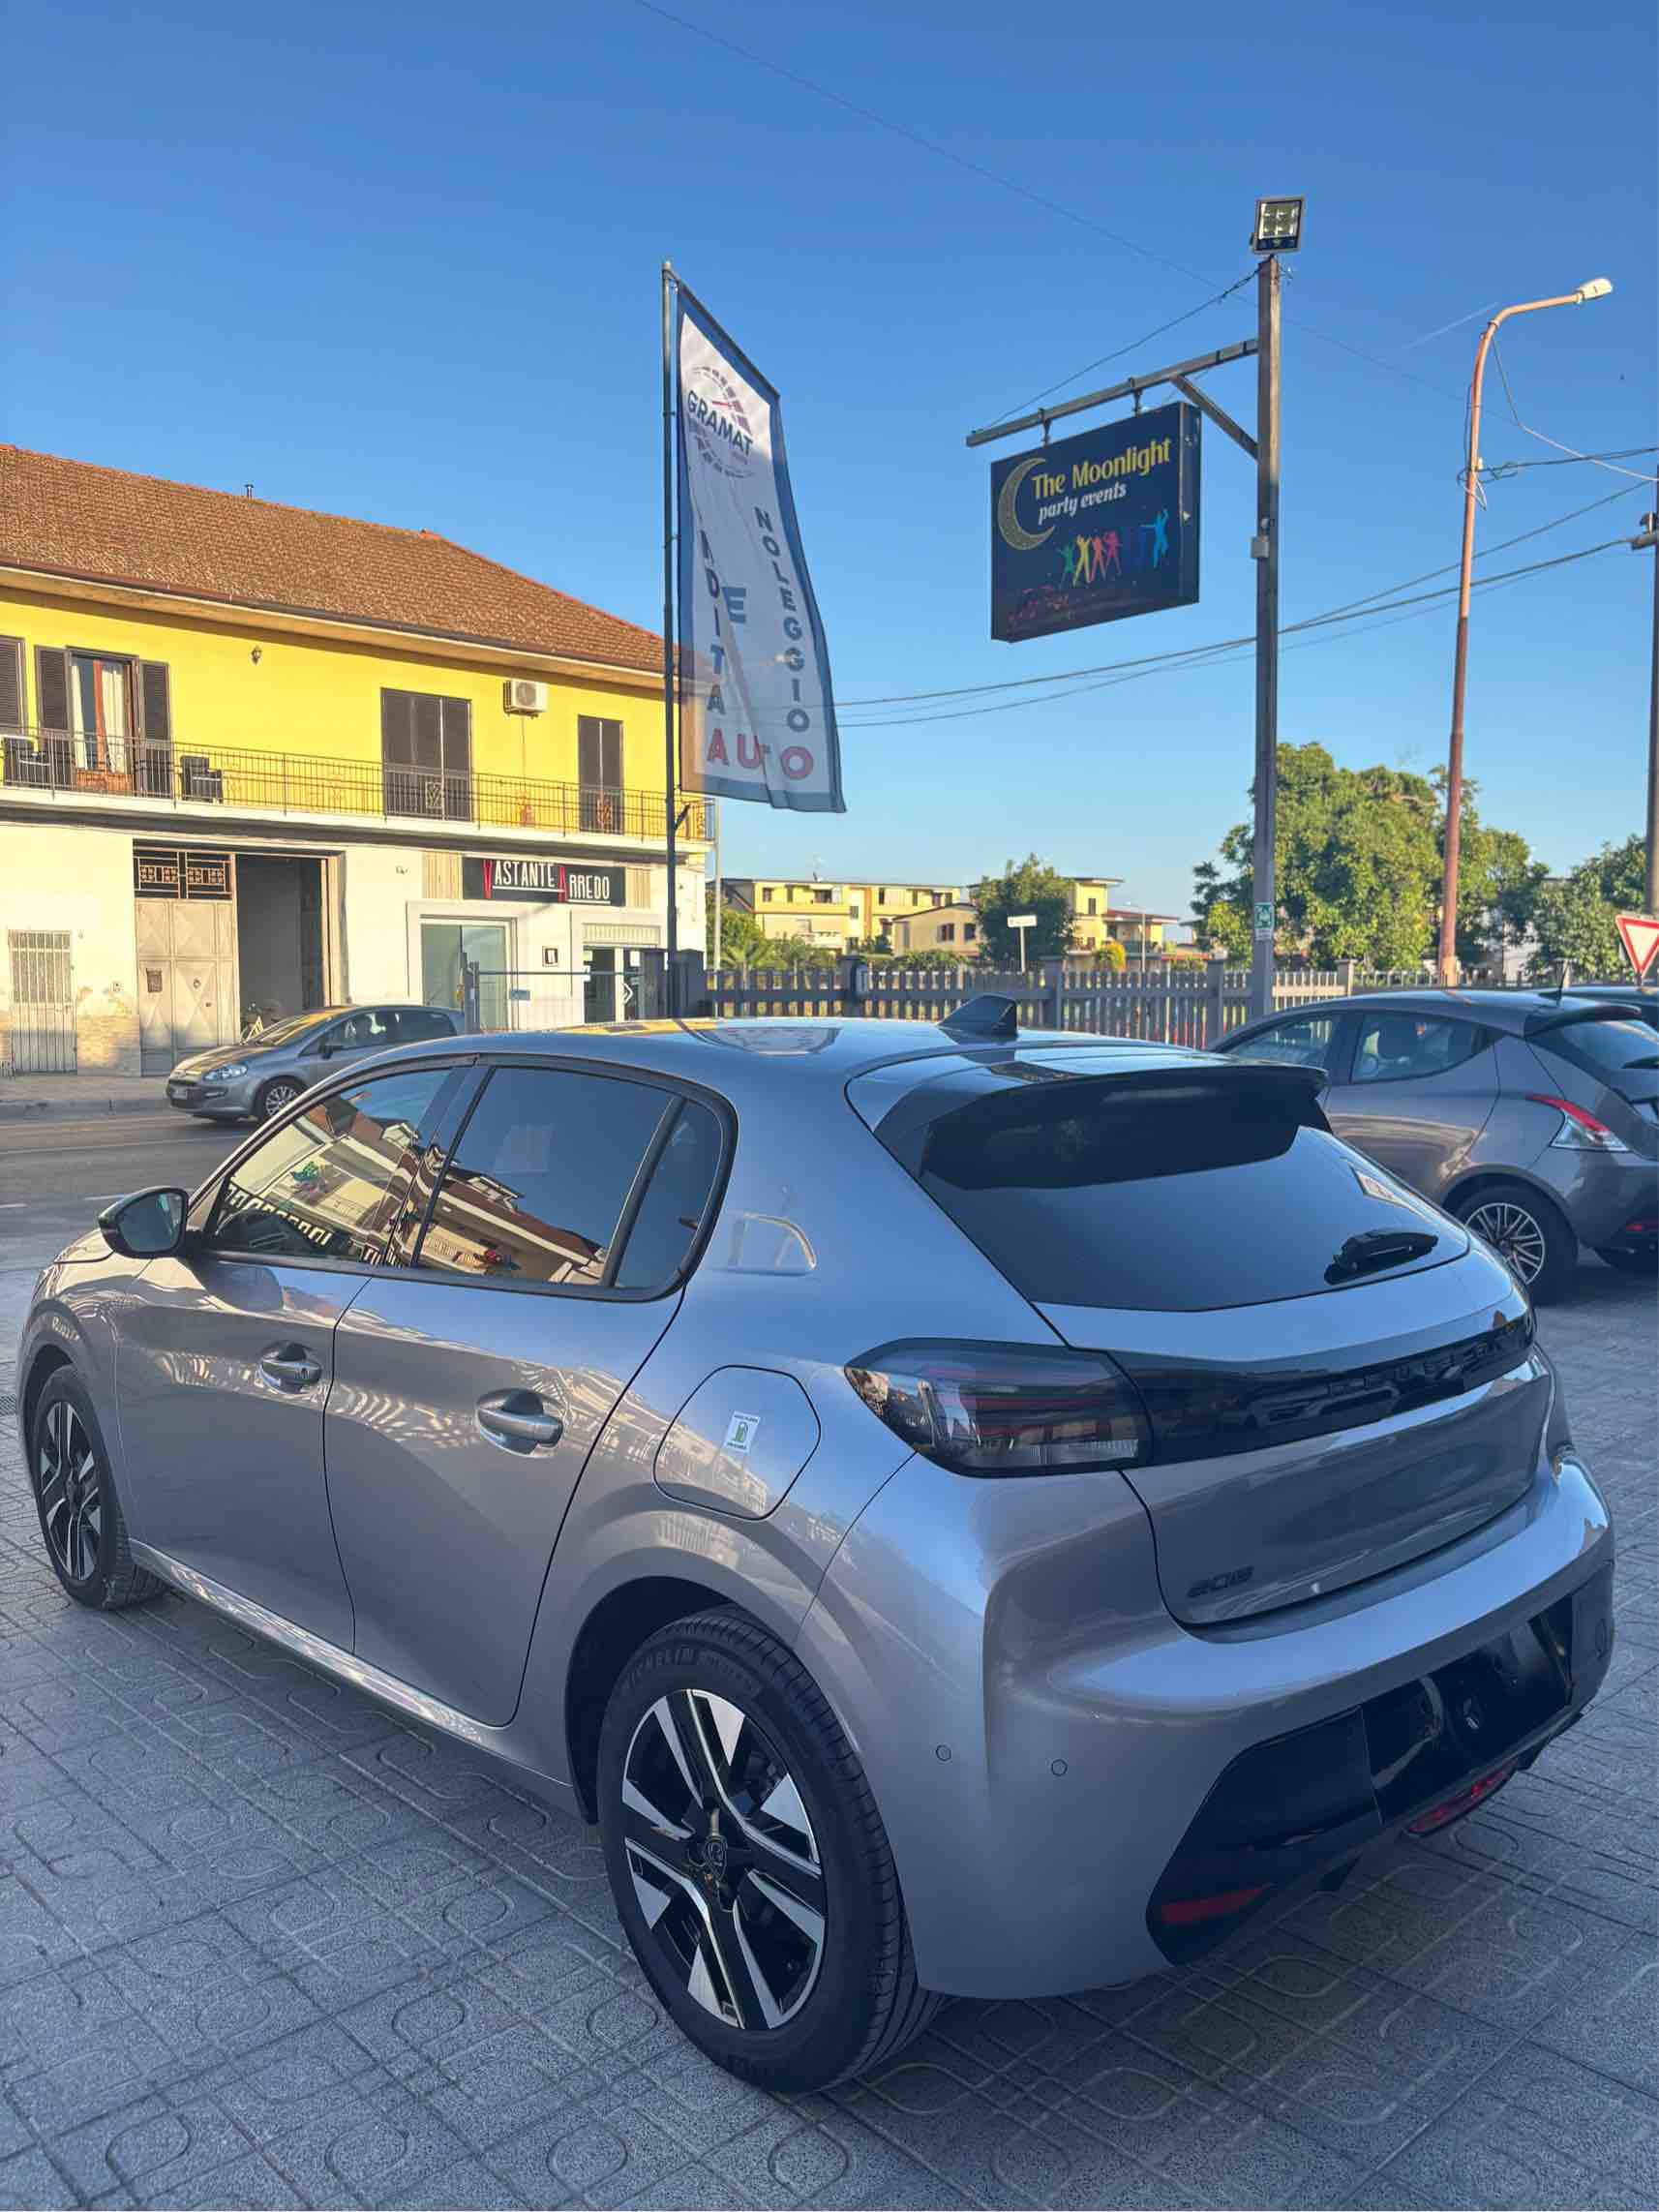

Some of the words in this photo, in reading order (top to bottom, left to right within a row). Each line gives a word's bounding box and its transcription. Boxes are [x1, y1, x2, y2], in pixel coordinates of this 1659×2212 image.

[688, 390, 753, 456] GRAMAT
[1032, 472, 1066, 500] The
[1071, 438, 1172, 489] Moonlight
[1038, 497, 1078, 525] party
[1080, 481, 1127, 507] events
[720, 587, 747, 624] E
[755, 506, 811, 733] NOLEGGIO
[707, 728, 814, 780] AUO
[482, 860, 556, 899] VASTANTE
[558, 865, 611, 903] ARREDO
